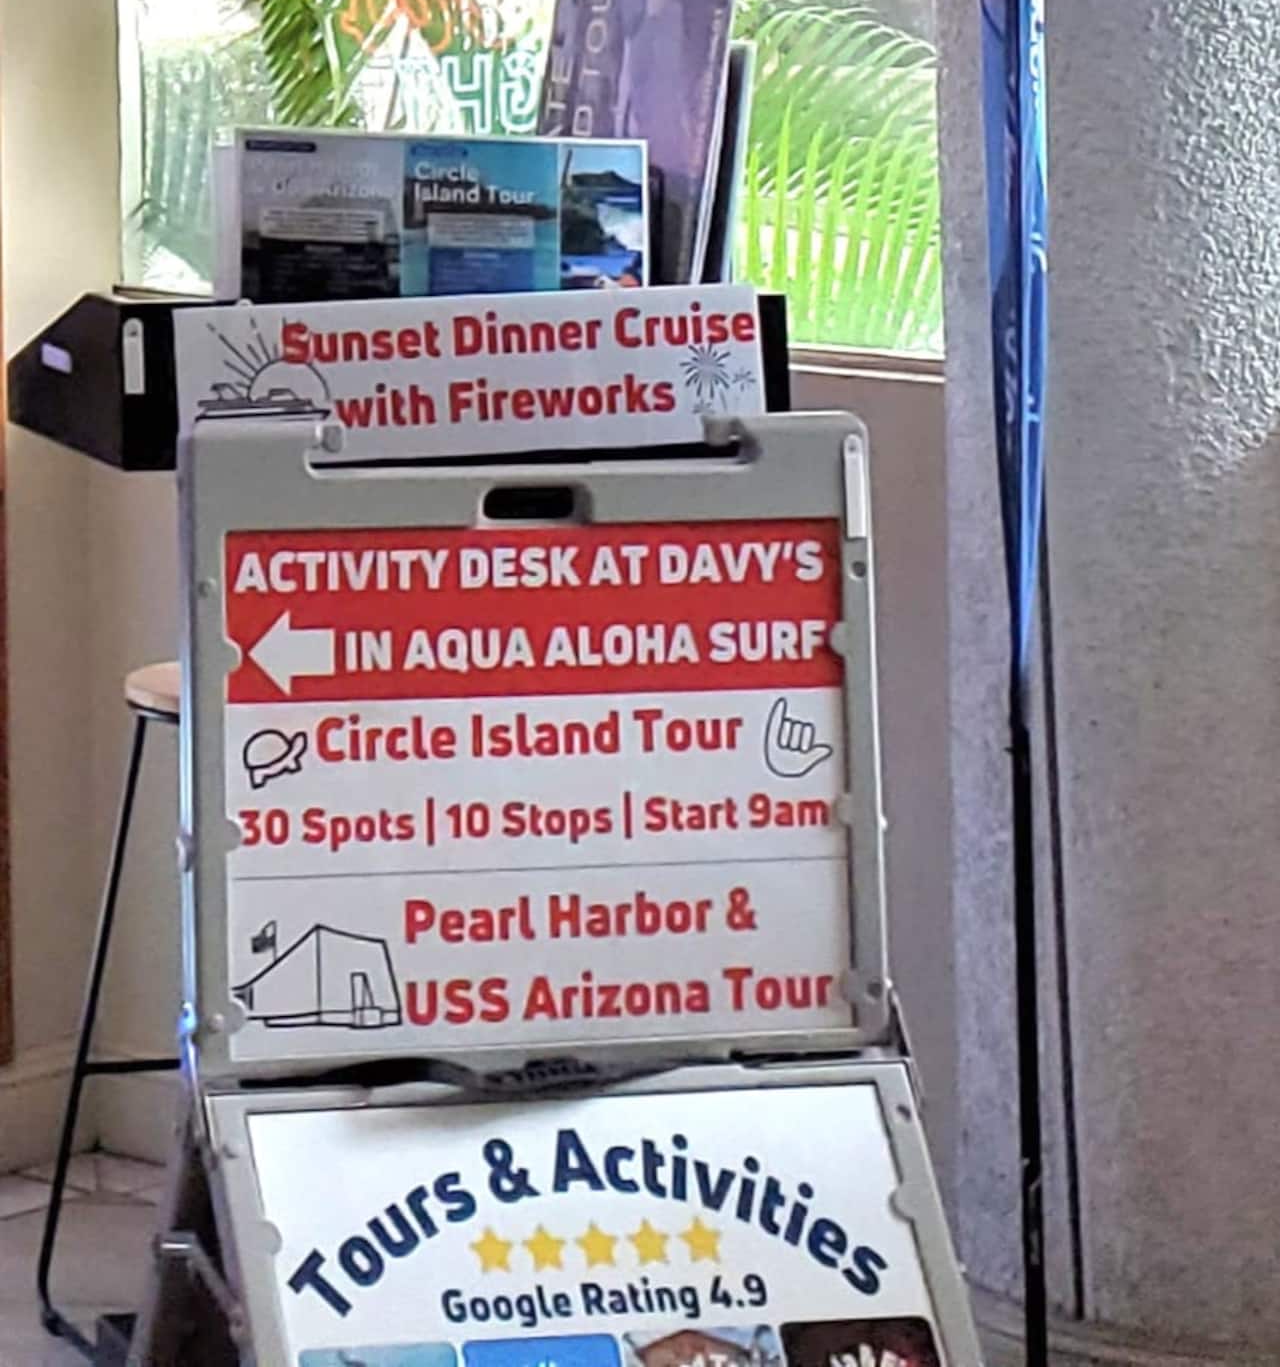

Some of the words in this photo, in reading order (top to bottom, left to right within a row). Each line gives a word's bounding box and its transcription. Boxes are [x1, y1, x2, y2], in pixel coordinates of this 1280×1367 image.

[414, 160, 481, 181] Circle
[414, 184, 481, 204] Island
[488, 185, 536, 205] Tour
[282, 324, 439, 363] Sunset
[453, 317, 598, 355] Dinner
[615, 310, 755, 346] Cruise
[336, 388, 435, 425] with
[450, 377, 673, 420] Fireworks
[236, 551, 447, 591] ACTIVITY
[461, 548, 579, 587] DESK
[591, 546, 648, 584] AT
[661, 542, 821, 582] DAVY'S
[347, 632, 392, 671] IN
[405, 629, 534, 671] AQUA
[546, 625, 698, 665] ALOHA
[711, 621, 824, 661] SURF
[315, 714, 456, 763] Circle
[471, 712, 619, 757] Island
[634, 708, 740, 752] Tour
[241, 808, 290, 846] 30
[303, 808, 415, 849] Spots
[447, 803, 491, 838] 10
[502, 803, 612, 838] Stops
[645, 797, 736, 832] Start
[749, 793, 830, 827] 9am
[404, 897, 534, 943] Pearl
[549, 895, 710, 937] Harbor
[727, 887, 756, 931] &
[406, 978, 510, 1024] USS
[524, 973, 709, 1019] Arizona
[725, 967, 831, 1009] Tour
[288, 1173, 477, 1318] Tours
[484, 1139, 538, 1202] &
[553, 1128, 887, 1296] Activities
[442, 1286, 571, 1327] Google
[581, 1278, 700, 1318] Rating
[711, 1274, 766, 1307] 4.9
